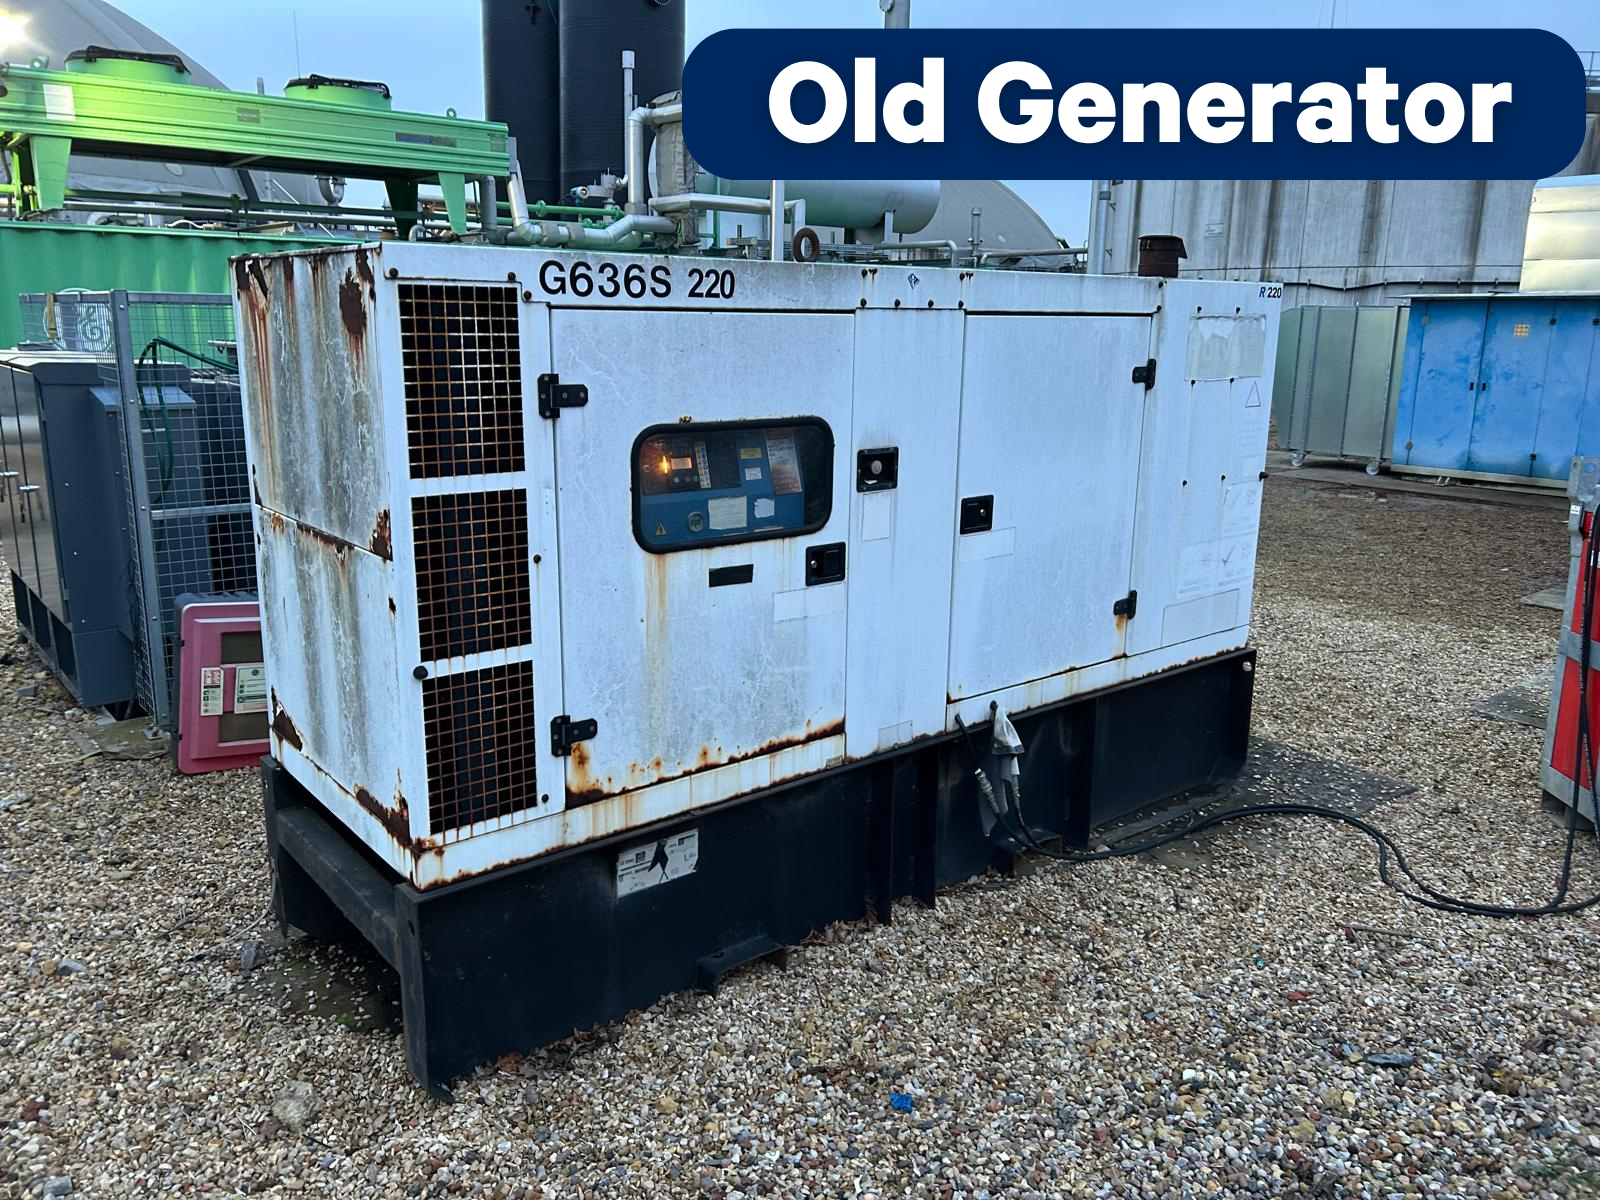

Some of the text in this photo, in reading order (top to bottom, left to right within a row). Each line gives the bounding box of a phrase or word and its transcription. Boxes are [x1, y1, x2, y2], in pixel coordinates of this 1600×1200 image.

[538, 259, 735, 299] G636S 220
[1258, 286, 1282, 298] R 220
